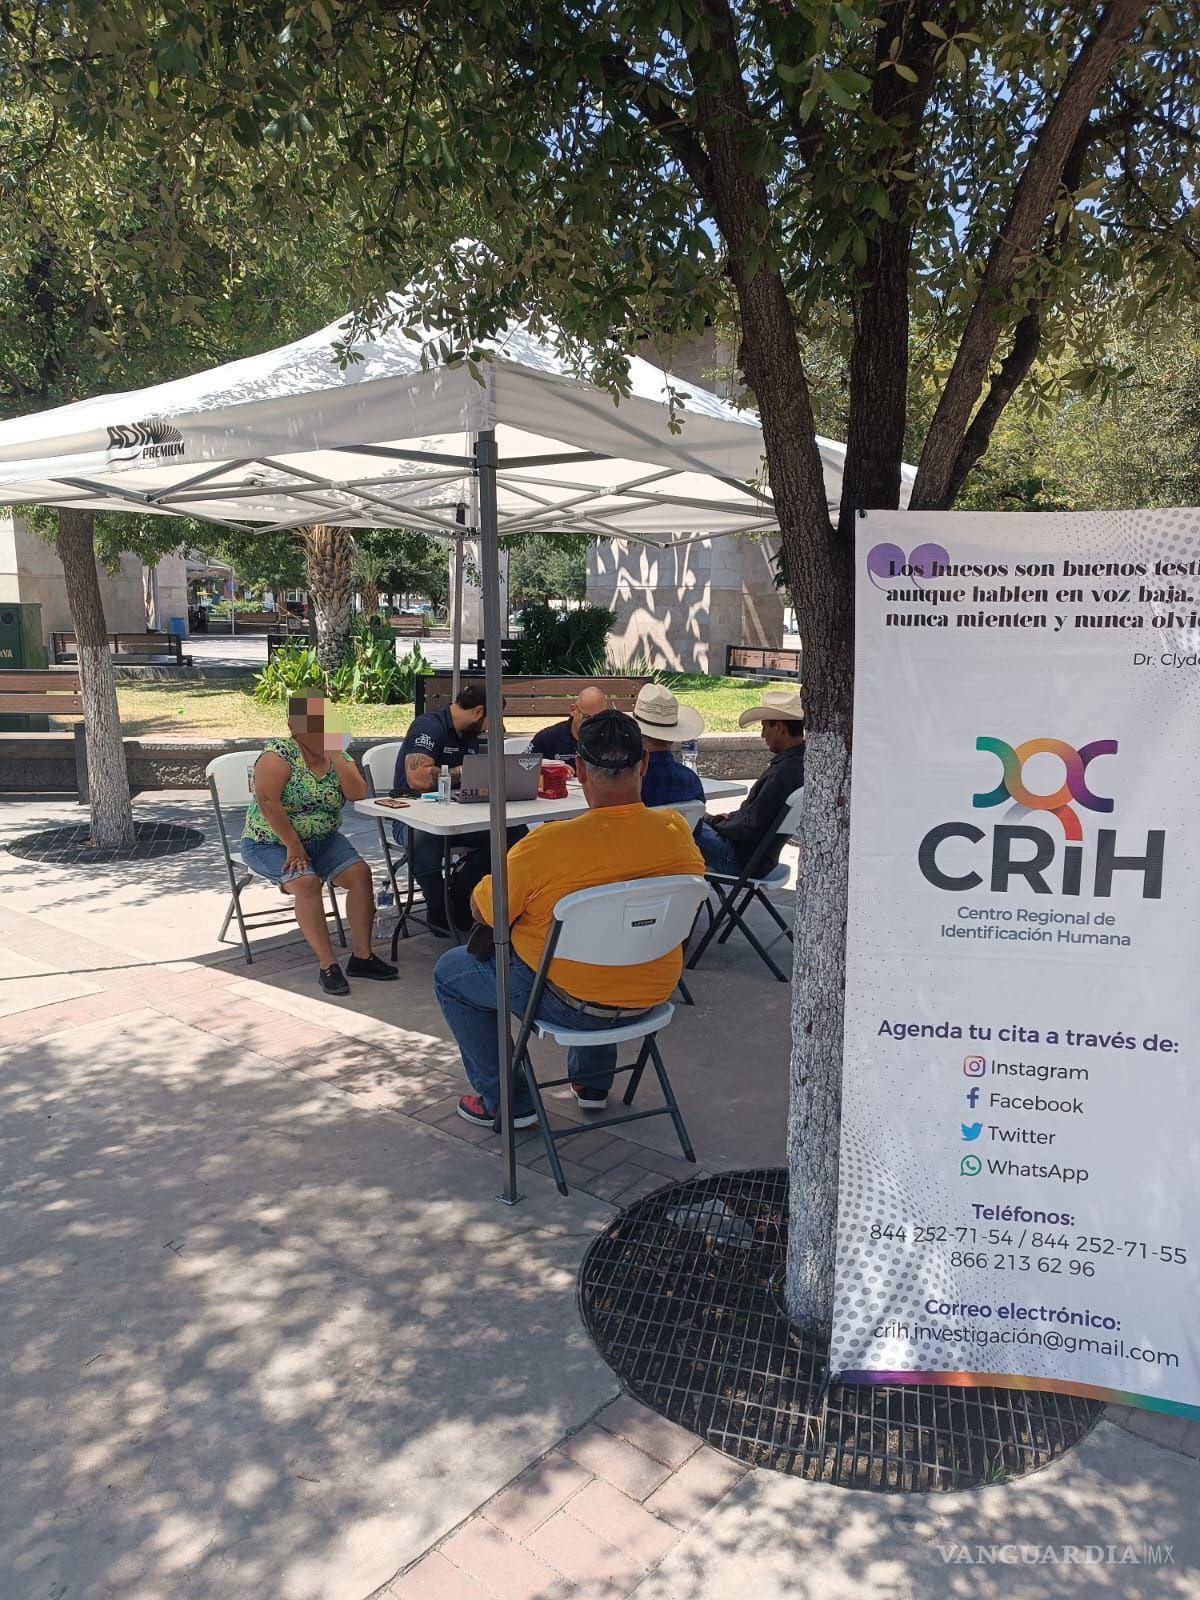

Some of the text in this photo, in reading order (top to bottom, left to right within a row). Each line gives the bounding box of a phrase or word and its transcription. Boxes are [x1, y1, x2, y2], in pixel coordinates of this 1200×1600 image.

[143, 443, 185, 459] PREMIUM
[889, 560, 925, 577] Los
[931, 560, 1008, 577] huesos
[1015, 563, 1055, 577] son
[1063, 560, 1147, 577] buenos
[886, 585, 1194, 605] aunque hablen en voz baja.
[886, 611, 1200, 632] nunca mienten y nunca olvi
[1133, 653, 1200, 669] Dr. Clyd
[957, 906, 1116, 926] Centro Regional de
[941, 924, 1132, 947] Identificación Humana
[877, 1020, 1179, 1053] Agenda tu cita a través de:
[991, 1060, 1089, 1081] Instagram
[989, 1092, 1084, 1114] Facebook
[987, 1125, 1056, 1145] Twitter
[987, 1159, 1089, 1184] WhatsApp
[972, 1203, 1075, 1226] Teléfonos:
[870, 1224, 1187, 1265] 844 252-71-54 / 844 252-71-55
[950, 1251, 1095, 1277] 866 213 62 96
[925, 1300, 1121, 1331] Correo electrónico:
[873, 1322, 1179, 1368] crih.investigación@gmail.com
